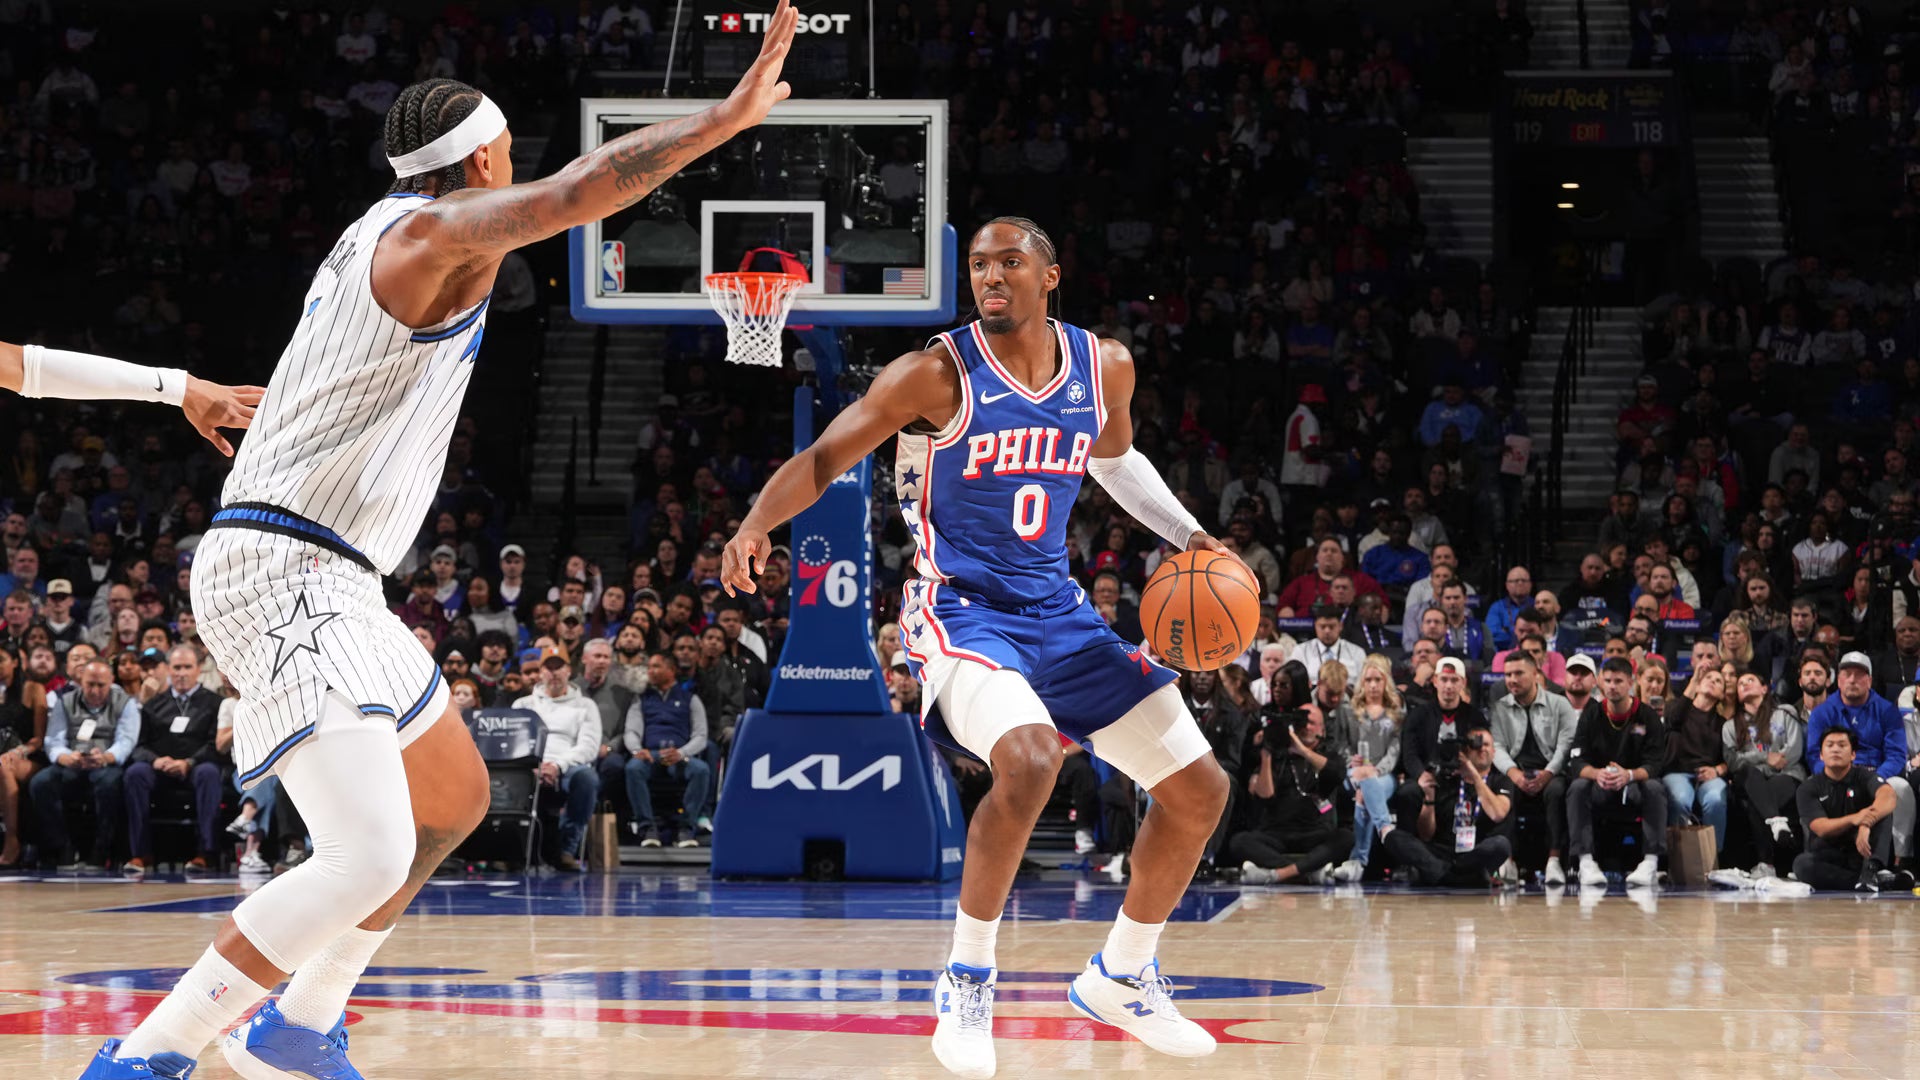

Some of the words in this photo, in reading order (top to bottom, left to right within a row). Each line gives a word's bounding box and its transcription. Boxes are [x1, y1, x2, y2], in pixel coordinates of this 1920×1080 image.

[743, 13, 851, 34] TISOT
[1563, 87, 1608, 112] Rock
[1513, 120, 1543, 144] 119
[1576, 123, 1601, 142] EXIT
[1631, 120, 1664, 144] 118
[1060, 406, 1094, 415] crypto.com
[962, 427, 1093, 480] PHILA
[1012, 484, 1050, 542] 0
[798, 559, 859, 608] 76
[780, 664, 874, 681] ticketmaster
[478, 717, 508, 732] NJM
[751, 753, 901, 791] KIA
